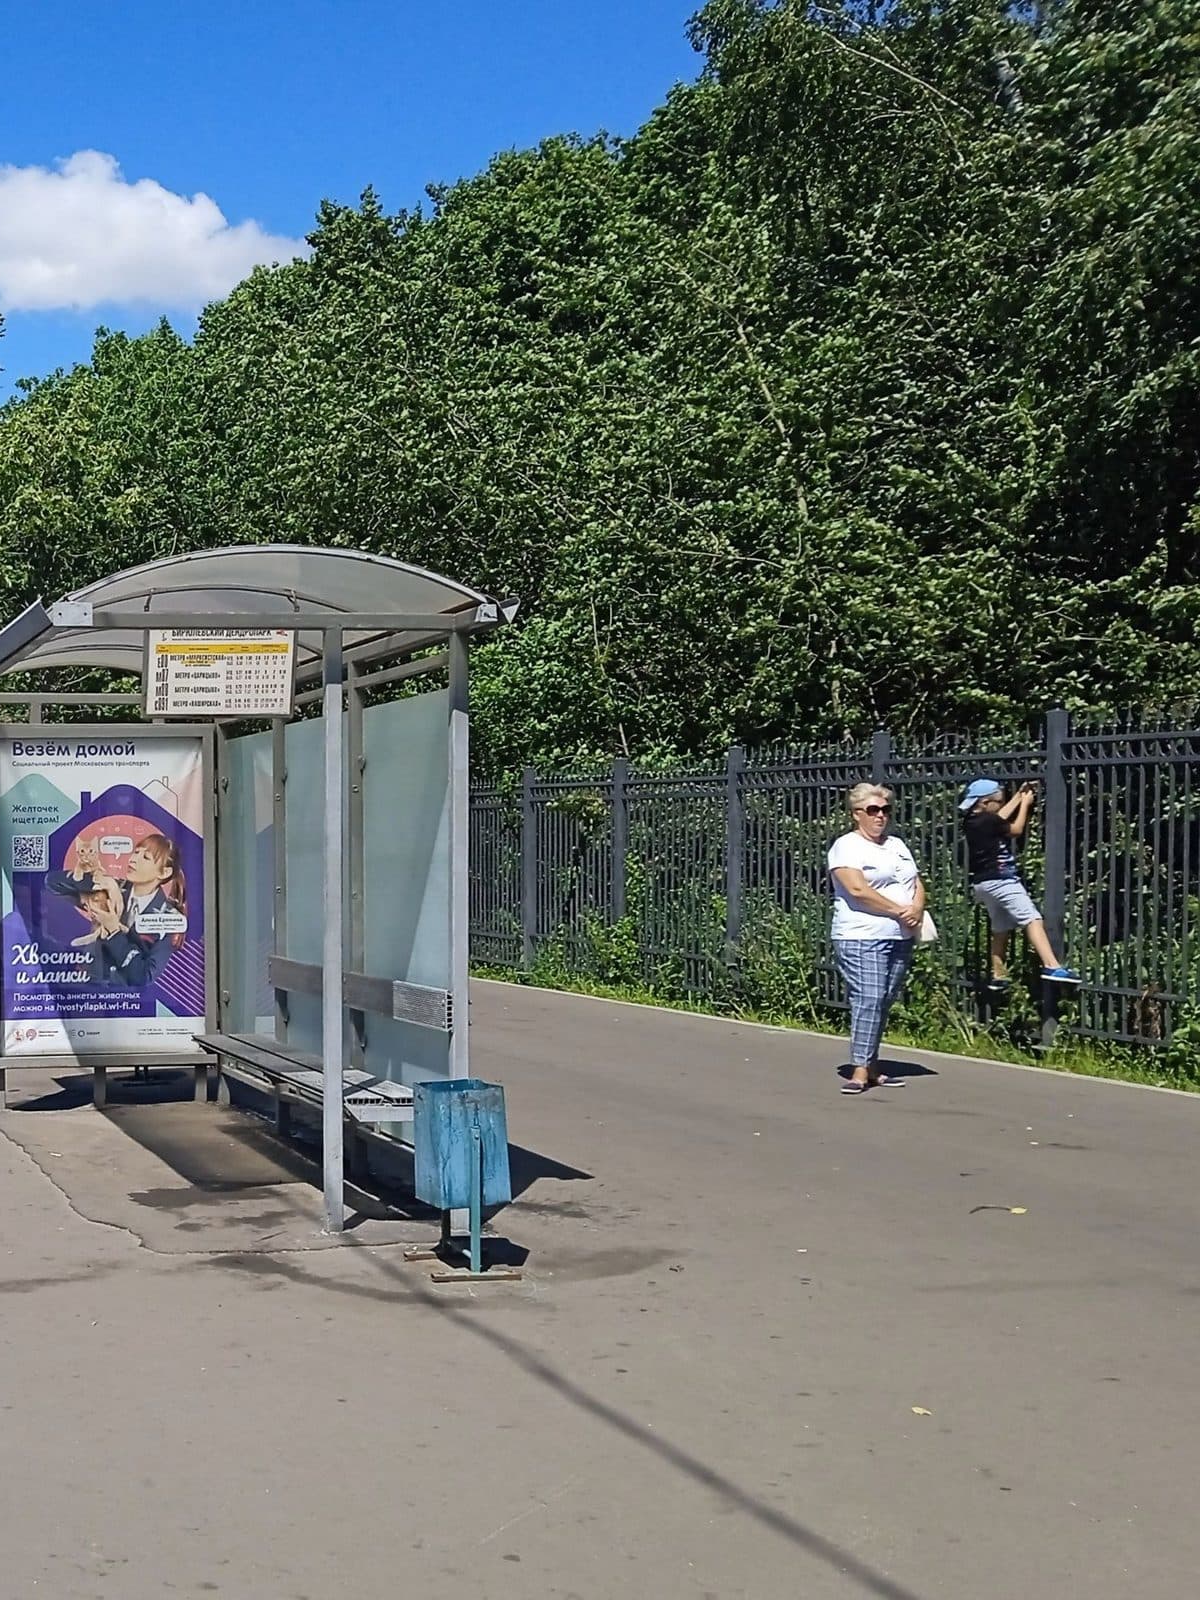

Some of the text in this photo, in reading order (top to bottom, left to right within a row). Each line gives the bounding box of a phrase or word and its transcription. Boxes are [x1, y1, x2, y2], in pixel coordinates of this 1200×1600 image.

[12, 740, 136, 758] Везём домой
[115, 760, 150, 768] транспорта
[11, 804, 59, 813] Желточек
[12, 815, 59, 825] ищет дом!
[11, 943, 94, 965] Хвосты
[16, 970, 91, 984] и лапки
[13, 992, 141, 1003] Посмотреть анкеты животных
[13, 1004, 43, 1013] можно
